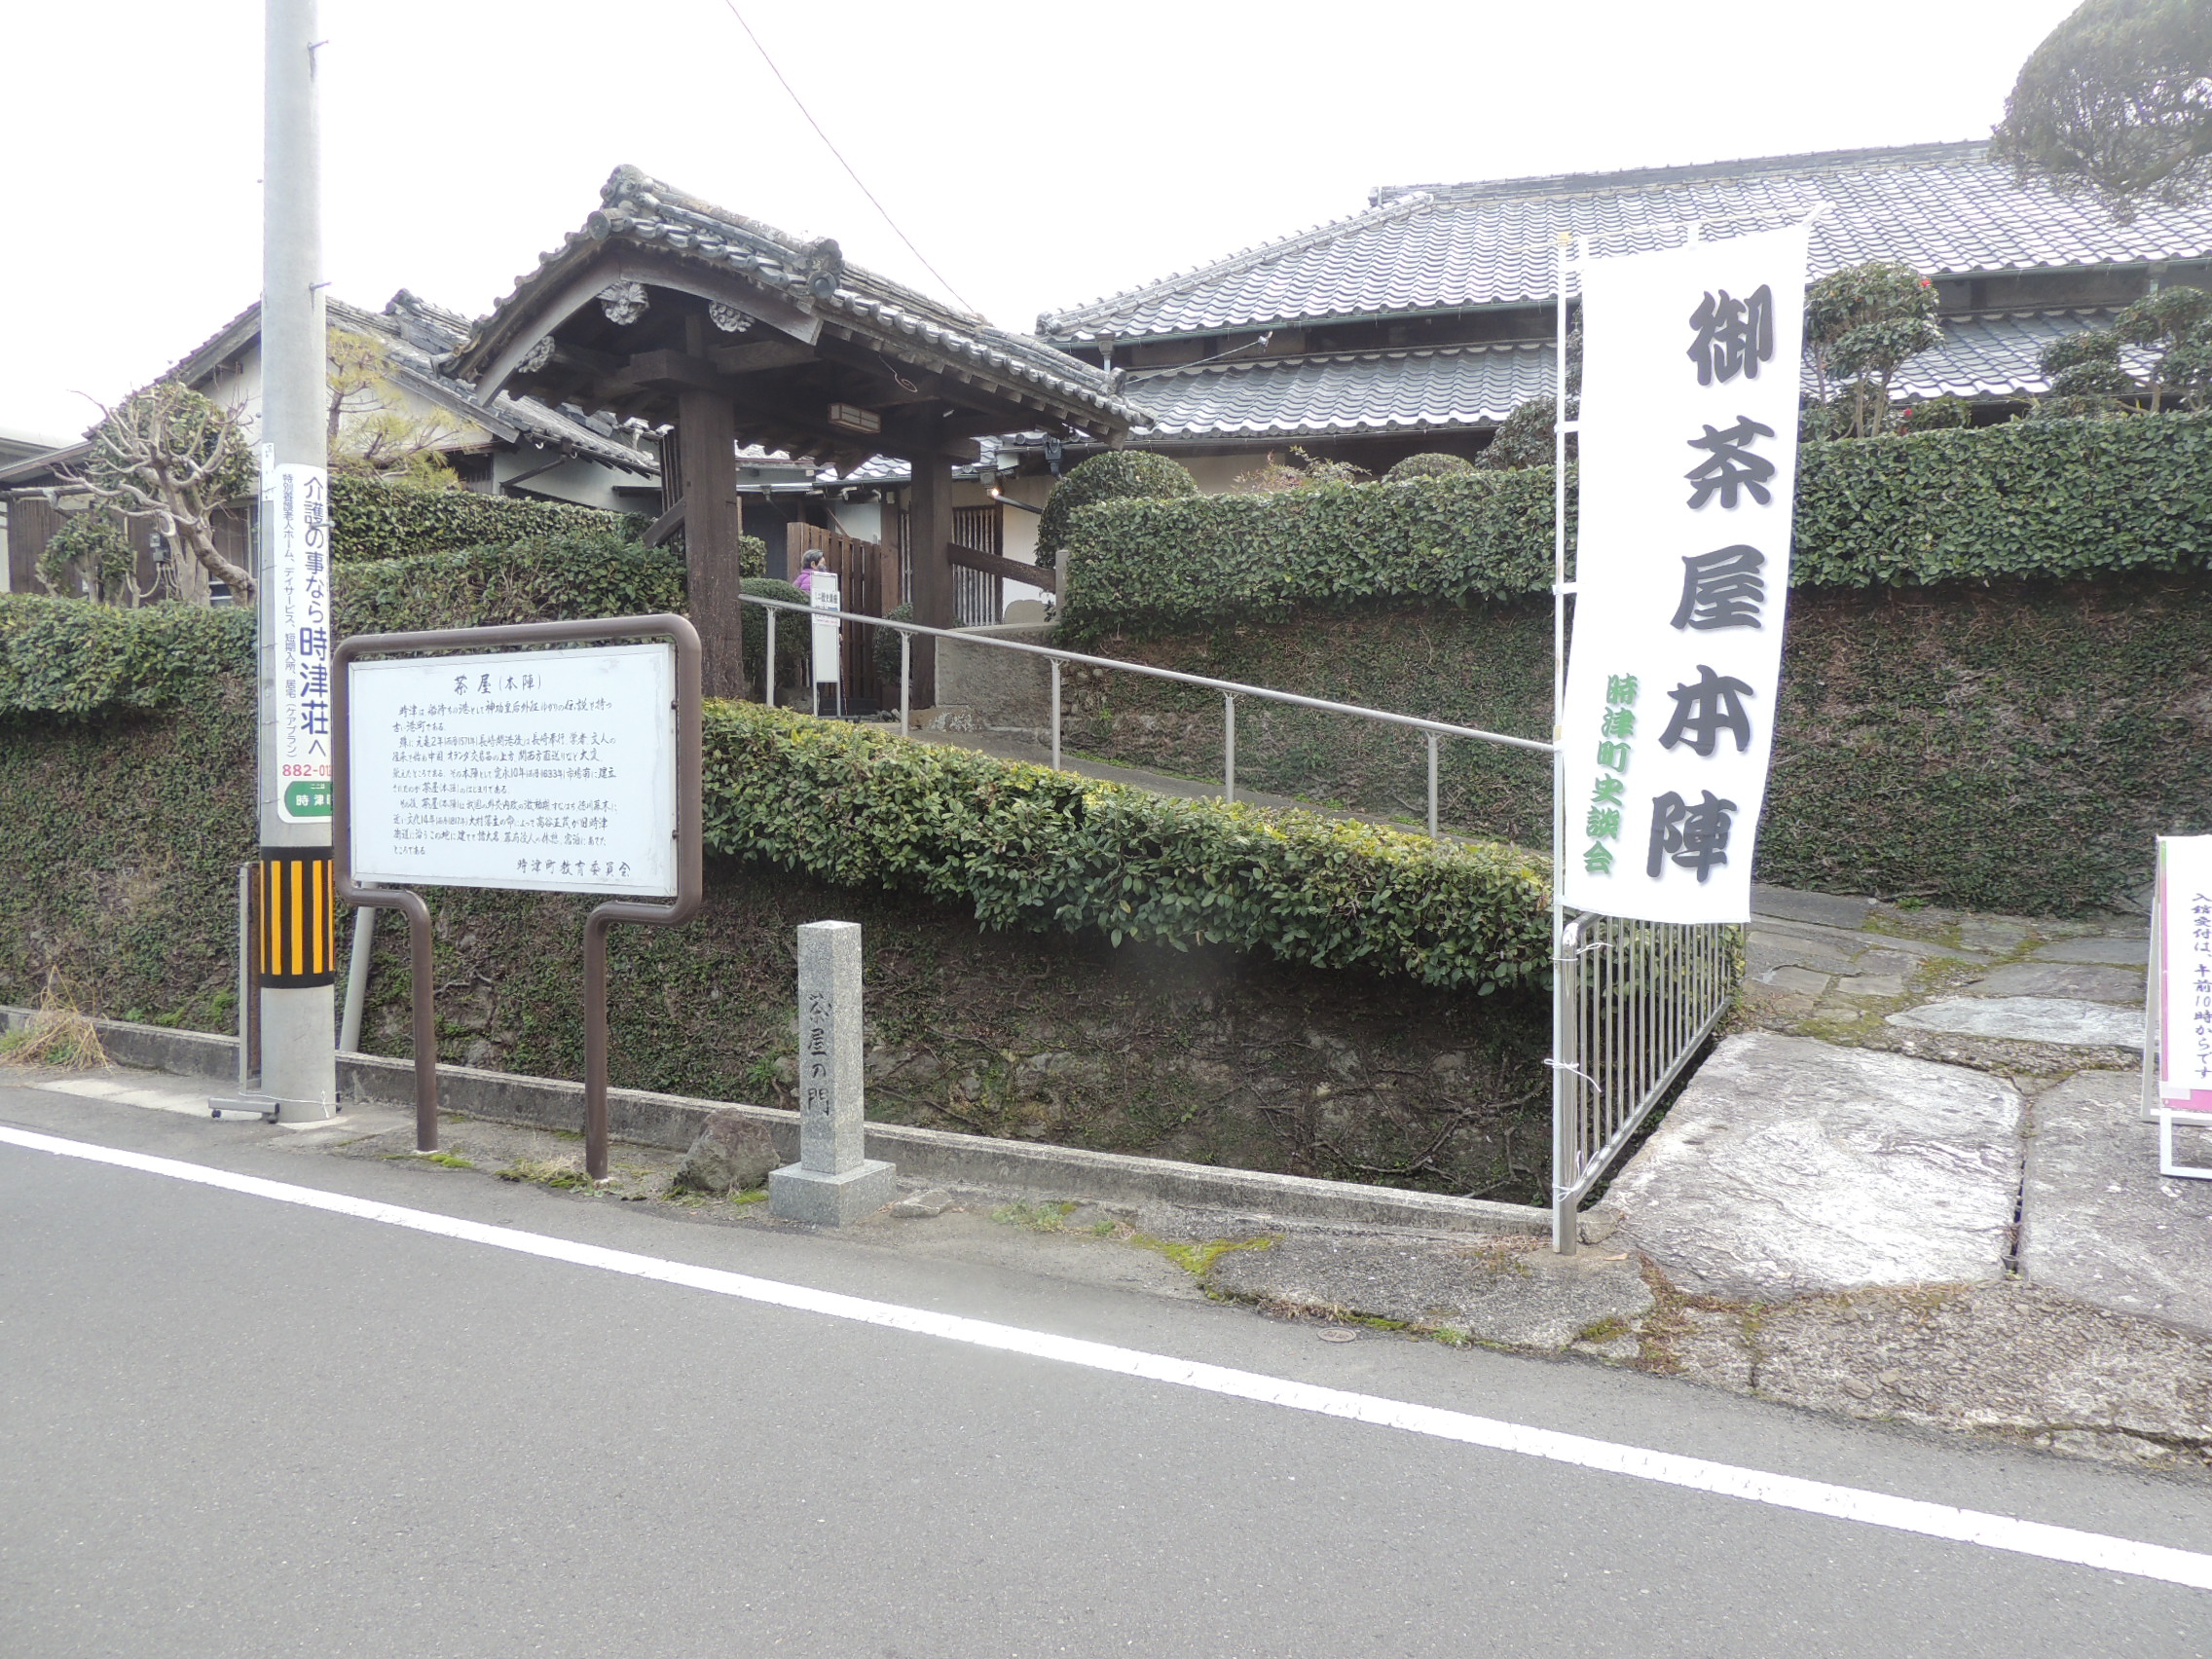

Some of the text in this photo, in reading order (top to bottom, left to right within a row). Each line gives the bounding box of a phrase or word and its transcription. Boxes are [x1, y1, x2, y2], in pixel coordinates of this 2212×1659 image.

[1583, 673, 1638, 874] 時津町史談会
[1646, 283, 1775, 883] 御茶屋本陣
